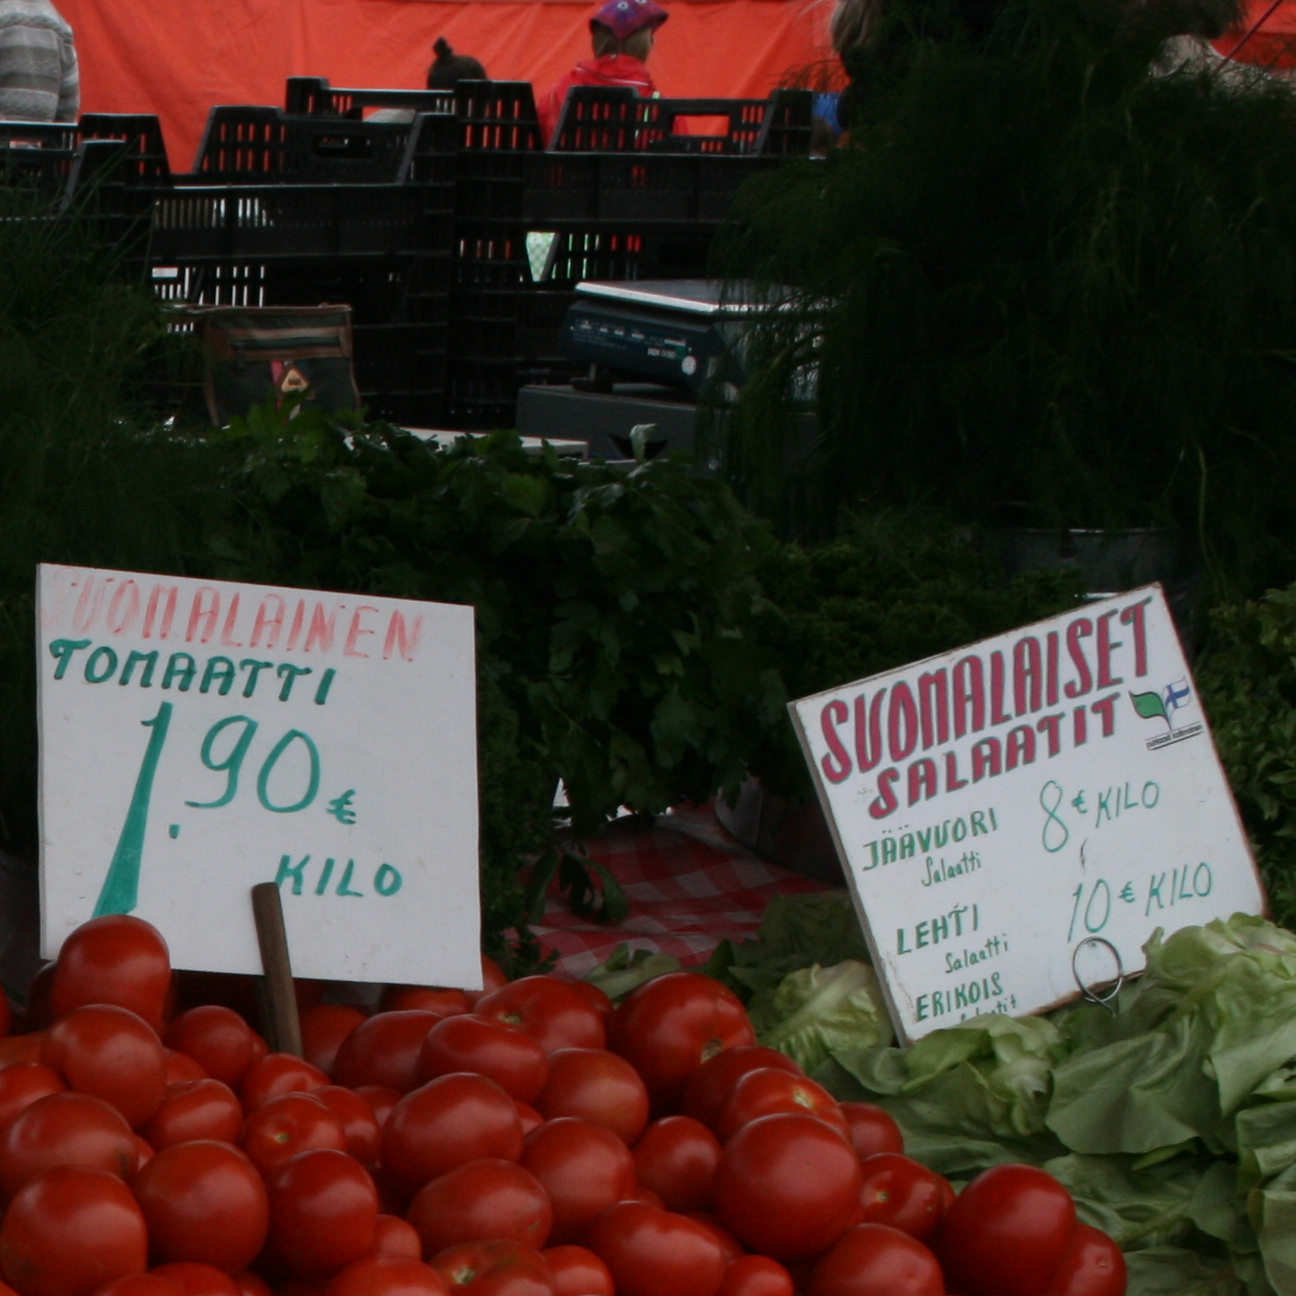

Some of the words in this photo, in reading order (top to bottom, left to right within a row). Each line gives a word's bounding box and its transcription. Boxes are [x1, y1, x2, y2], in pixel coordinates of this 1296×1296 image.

[44, 568, 424, 662] SUOMALAINEN
[49, 638, 337, 706] TOMAATTI
[820, 596, 1154, 785] SUOMALAISET
[868, 691, 1123, 819] SALAATIT
[862, 807, 998, 872] JÄÄVUORI
[1039, 779, 1070, 853] 8
[1071, 788, 1089, 814] €
[1094, 780, 1161, 829] KILO
[274, 854, 404, 898] KILO
[921, 850, 983, 887] Salaatti
[896, 903, 980, 956] LEHTI
[1067, 878, 1111, 944] 10
[1117, 880, 1136, 904] €
[1144, 861, 1213, 918] KILO
[944, 932, 1010, 974] Salaatti
[915, 971, 1005, 1023] ERIKOIS
